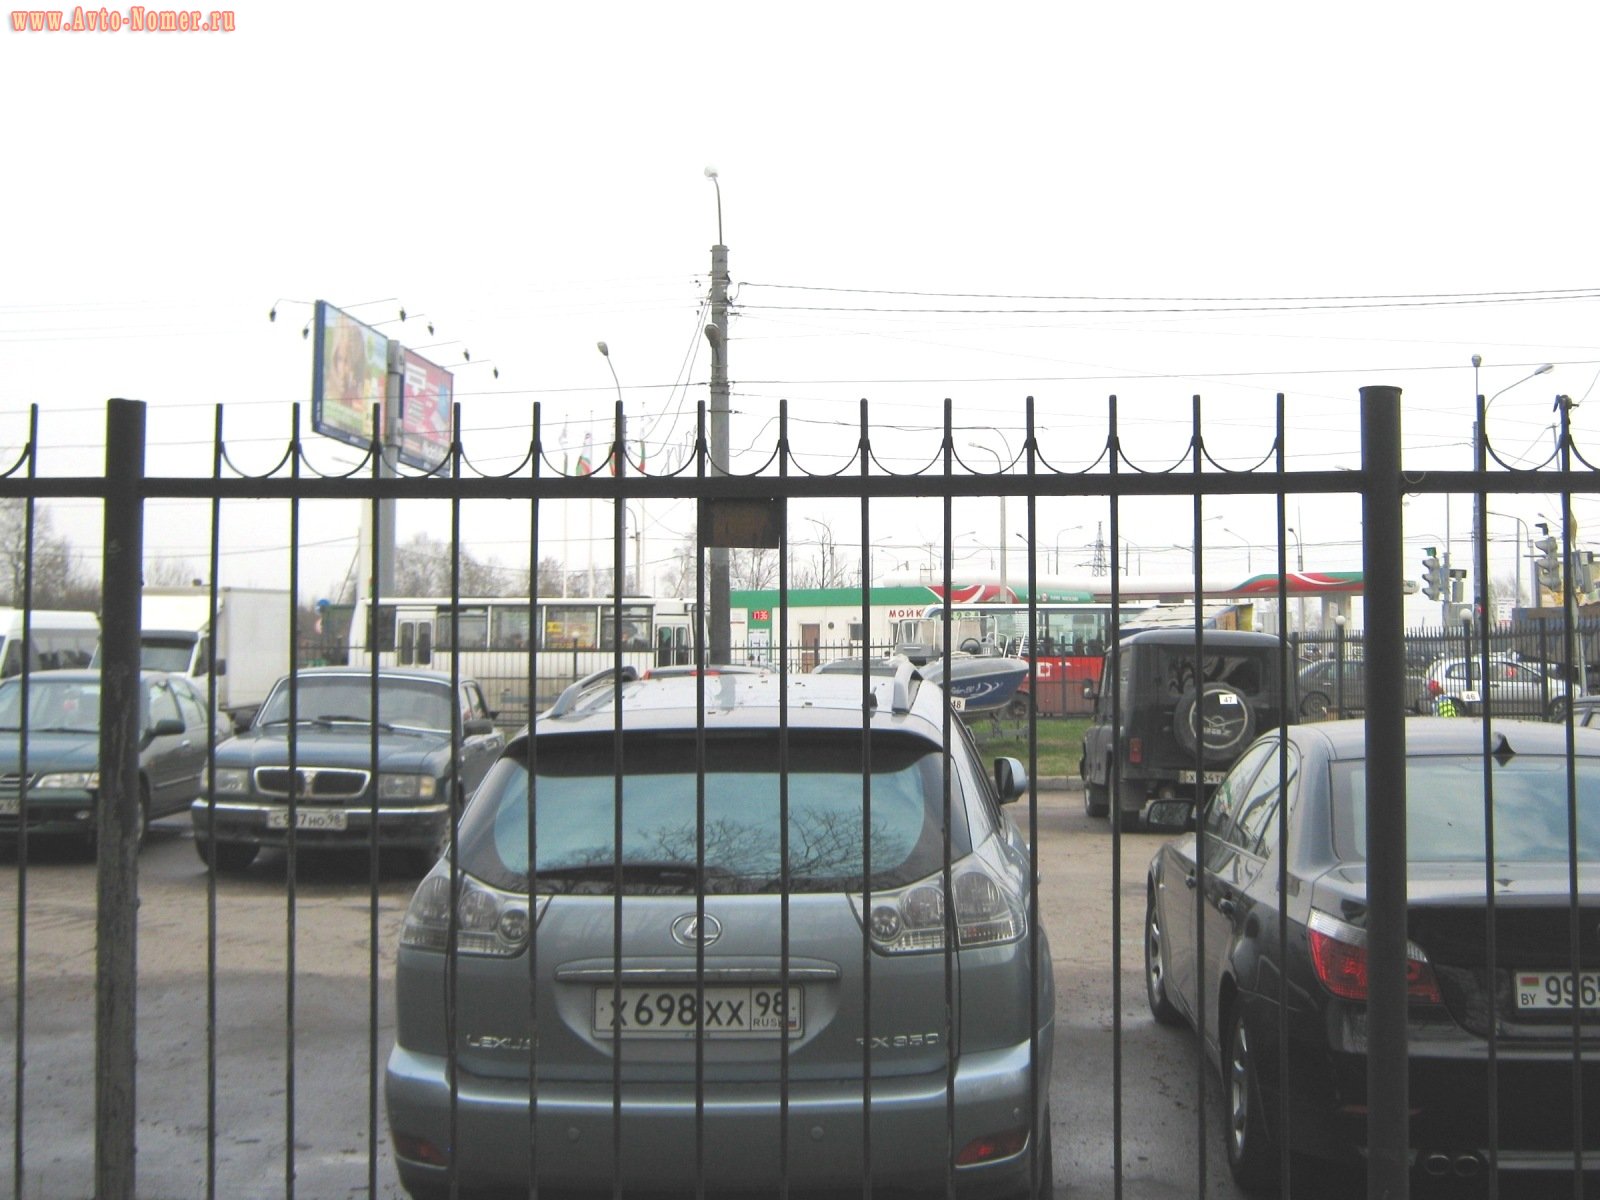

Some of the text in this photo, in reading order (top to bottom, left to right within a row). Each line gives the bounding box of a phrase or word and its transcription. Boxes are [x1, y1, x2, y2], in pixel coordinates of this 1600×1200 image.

[1223, 696, 1233, 704] 47
[1544, 975, 1600, 1006] 996
[1520, 993, 1537, 1006] BY
